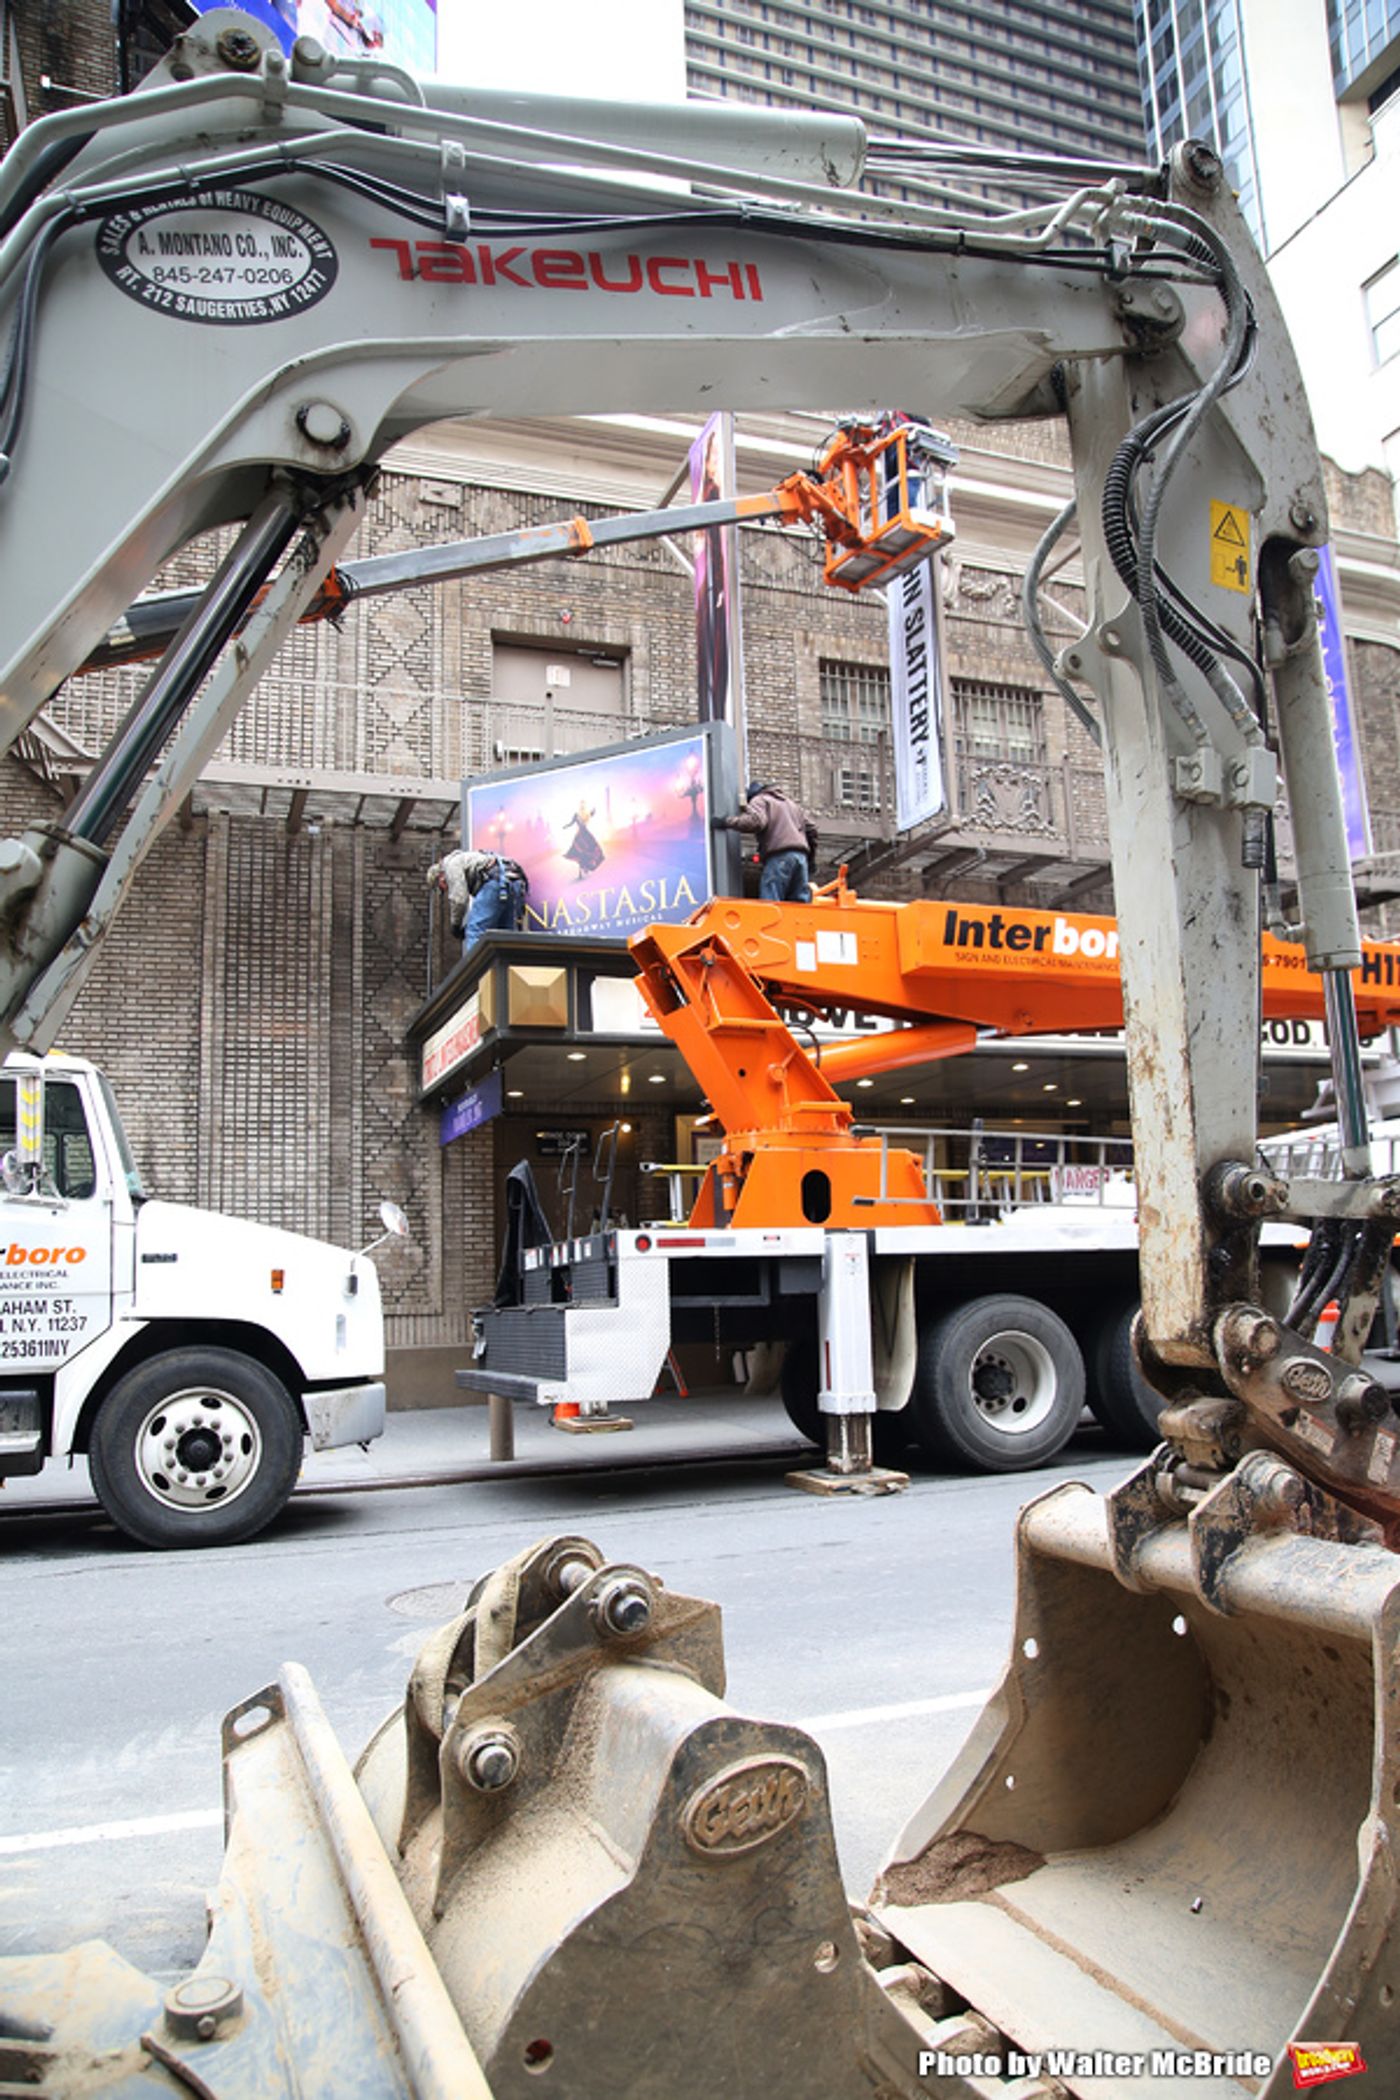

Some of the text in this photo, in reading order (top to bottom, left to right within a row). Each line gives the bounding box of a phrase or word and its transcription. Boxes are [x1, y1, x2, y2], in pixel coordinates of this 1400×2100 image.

[101, 214, 132, 256] SALES
[213, 190, 260, 214] HEAVY
[261, 201, 334, 260] EQUIPMENT
[138, 230, 156, 255] A.
[158, 232, 233, 258] MONTANO
[270, 235, 304, 259] INC.
[115, 264, 138, 291] RT.
[141, 283, 177, 308] 212
[290, 267, 328, 304] 12477
[152, 265, 294, 285] 845-247-0206
[904, 606, 930, 747] SLATTERY
[523, 874, 699, 931] NASTASIA
[616, 912, 663, 927] MUSICAL
[943, 909, 1120, 959] Interbor
[955, 951, 979, 963] SIGN
[981, 952, 1001, 965] AND
[1003, 955, 1056, 968] ELECTRICAL
[1361, 951, 1400, 986] H1
[0, 1269, 68, 1280] ELECTRICAL
[35, 1280, 60, 1290] INC.
[0, 1299, 77, 1316] AHAM ST.
[11, 1318, 42, 1333] N.Y.
[48, 1316, 88, 1332] 11237
